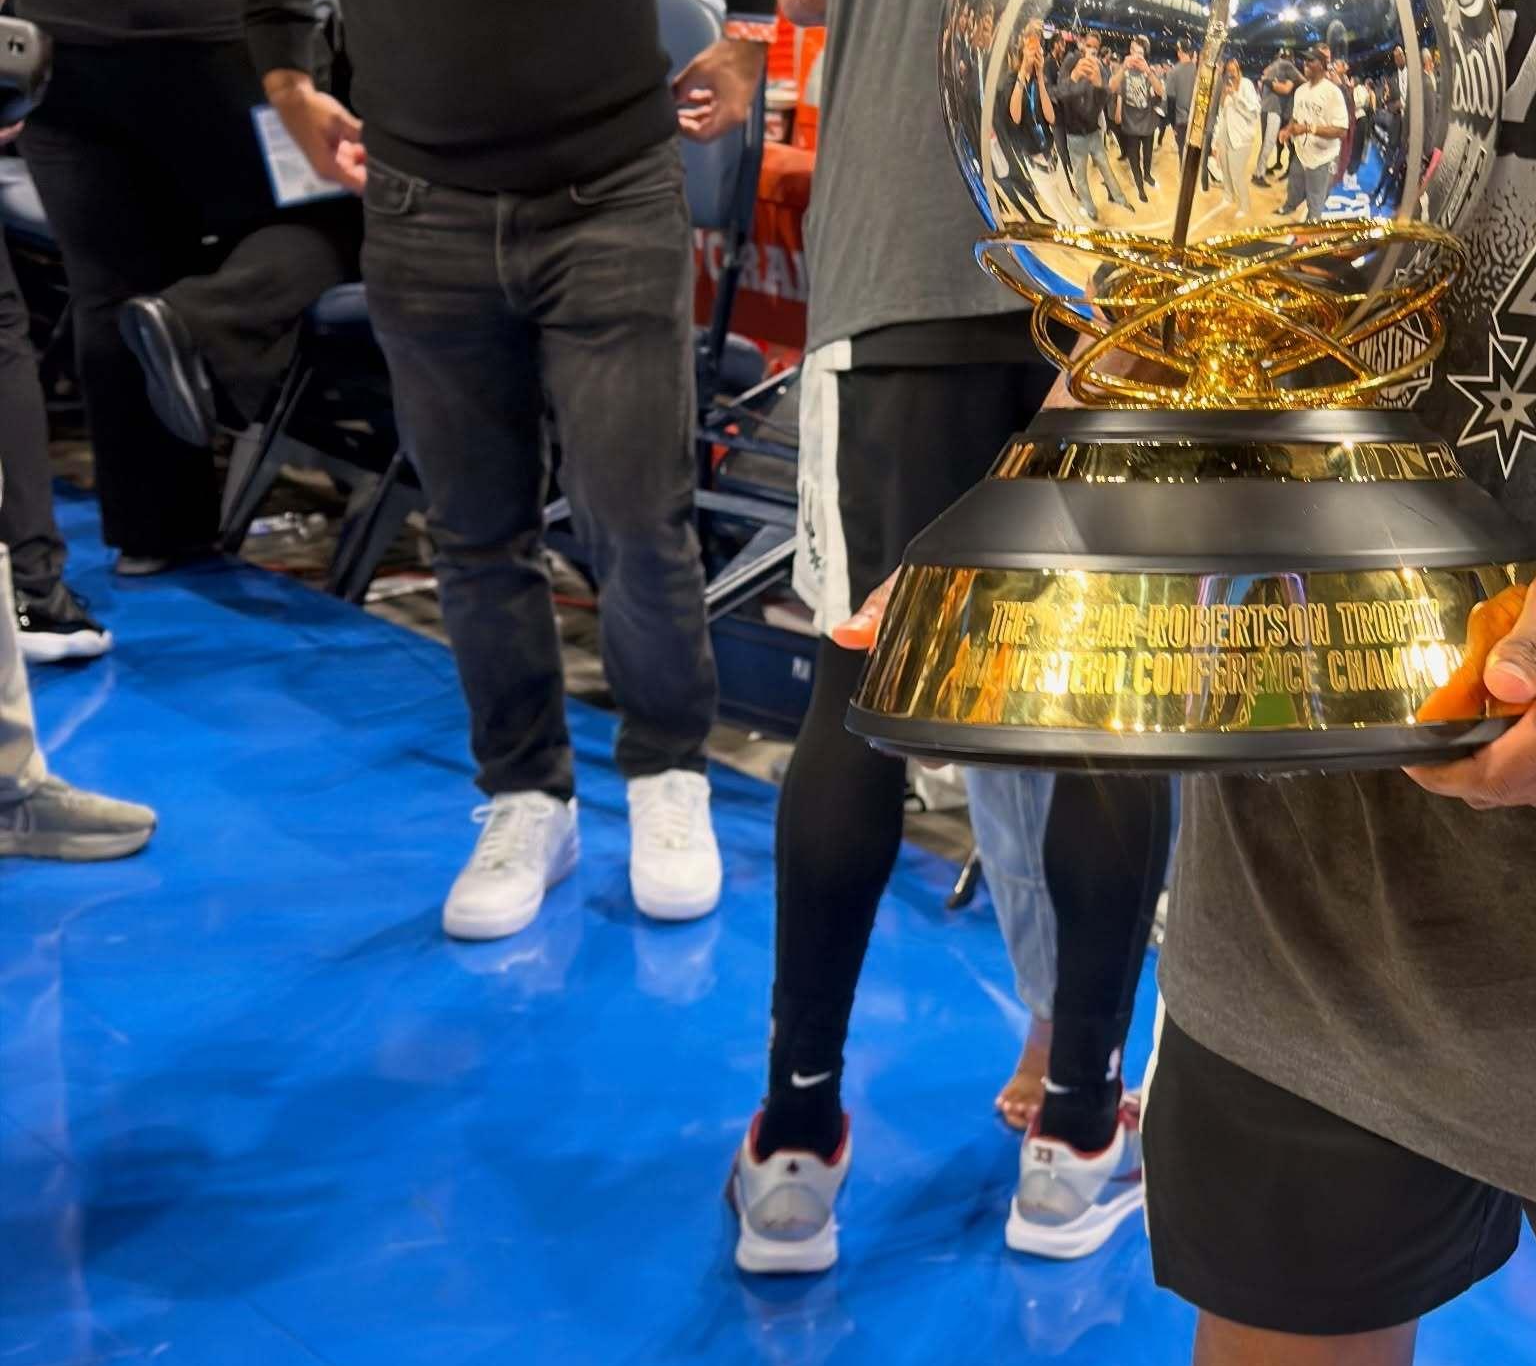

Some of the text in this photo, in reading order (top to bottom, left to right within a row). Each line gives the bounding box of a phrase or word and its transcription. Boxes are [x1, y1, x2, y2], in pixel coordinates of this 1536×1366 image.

[987, 600, 1035, 645] THE
[1146, 603, 1331, 649] ROBERTSON
[1335, 598, 1446, 646] TROPHY
[1133, 650, 1321, 696] CONFERENCE
